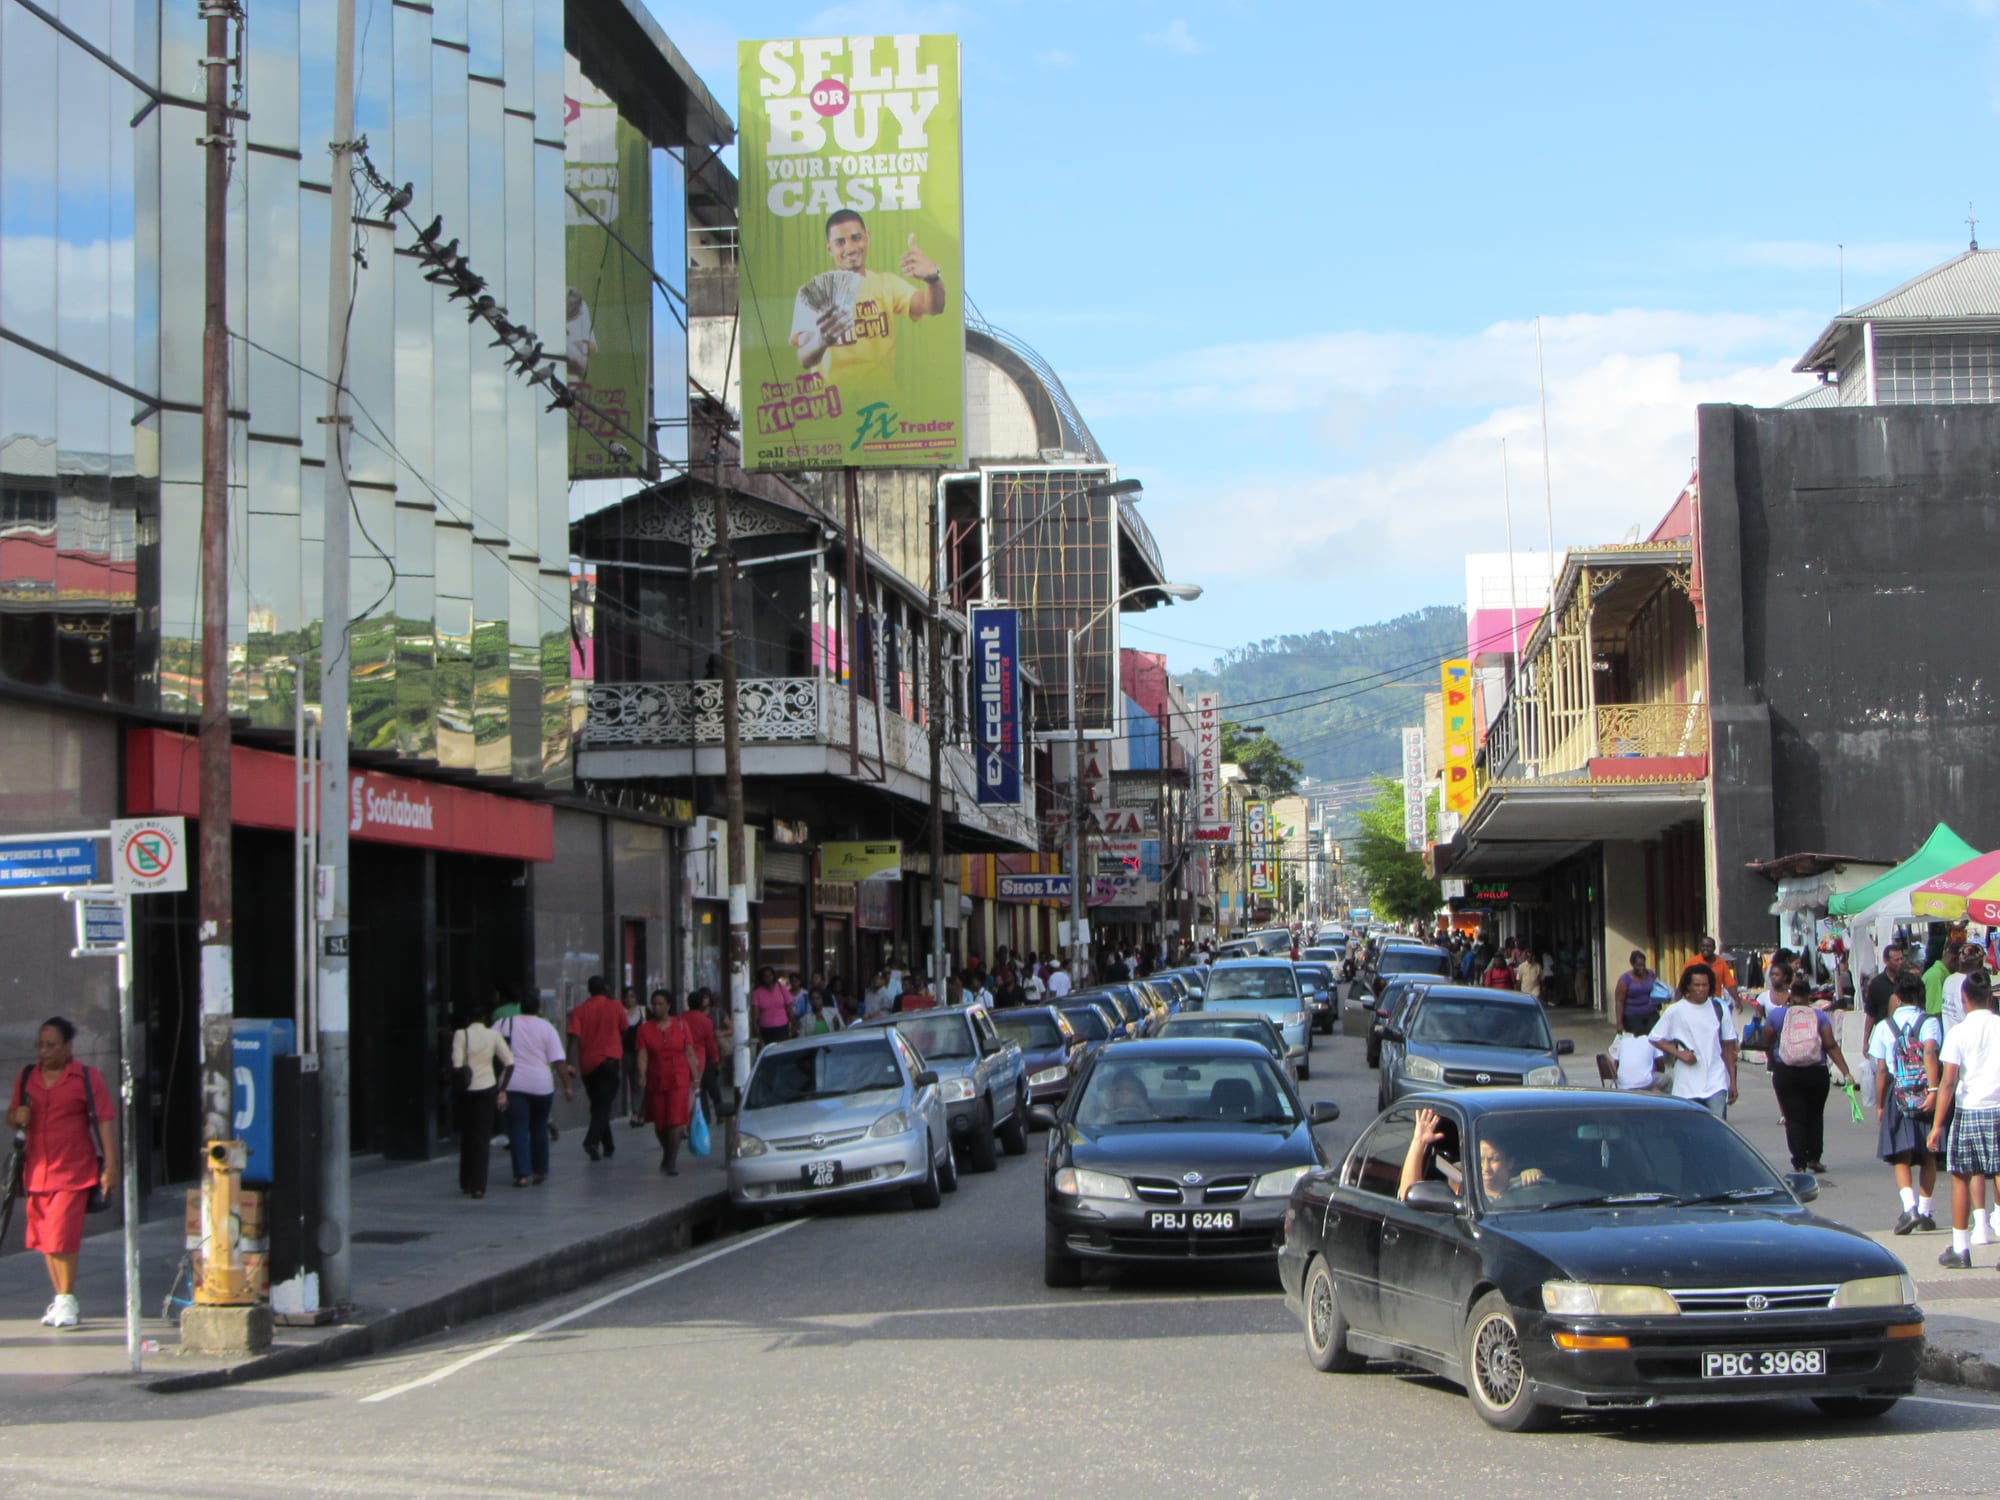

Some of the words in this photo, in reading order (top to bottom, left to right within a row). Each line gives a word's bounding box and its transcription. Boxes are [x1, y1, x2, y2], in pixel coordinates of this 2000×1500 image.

[759, 34, 939, 97] SELL
[813, 90, 844, 106] OR
[764, 91, 939, 156] BUY
[766, 157, 824, 180] YOUR
[828, 152, 928, 176] FOREIGN
[766, 175, 922, 218] CASH
[761, 382, 793, 402] Now
[796, 372, 824, 394] Yuh
[757, 386, 842, 434] Know!
[899, 420, 955, 434] Trader
[758, 447, 784, 459] call
[980, 625, 1002, 787] excellent
[1201, 697, 1214, 743] TOWN
[1202, 747, 1215, 817] CENTRE
[367, 787, 434, 831] Scotiabank
[1248, 807, 1266, 888] COURTS
[1001, 879, 1044, 895] SHOE
[806, 1161, 835, 1176] PBS
[812, 1172, 834, 1187] 416
[1151, 1212, 1187, 1230] PBJ
[1192, 1211, 1234, 1230] 6246
[1706, 1353, 1754, 1376] PBC
[1760, 1350, 1821, 1375] 3968
